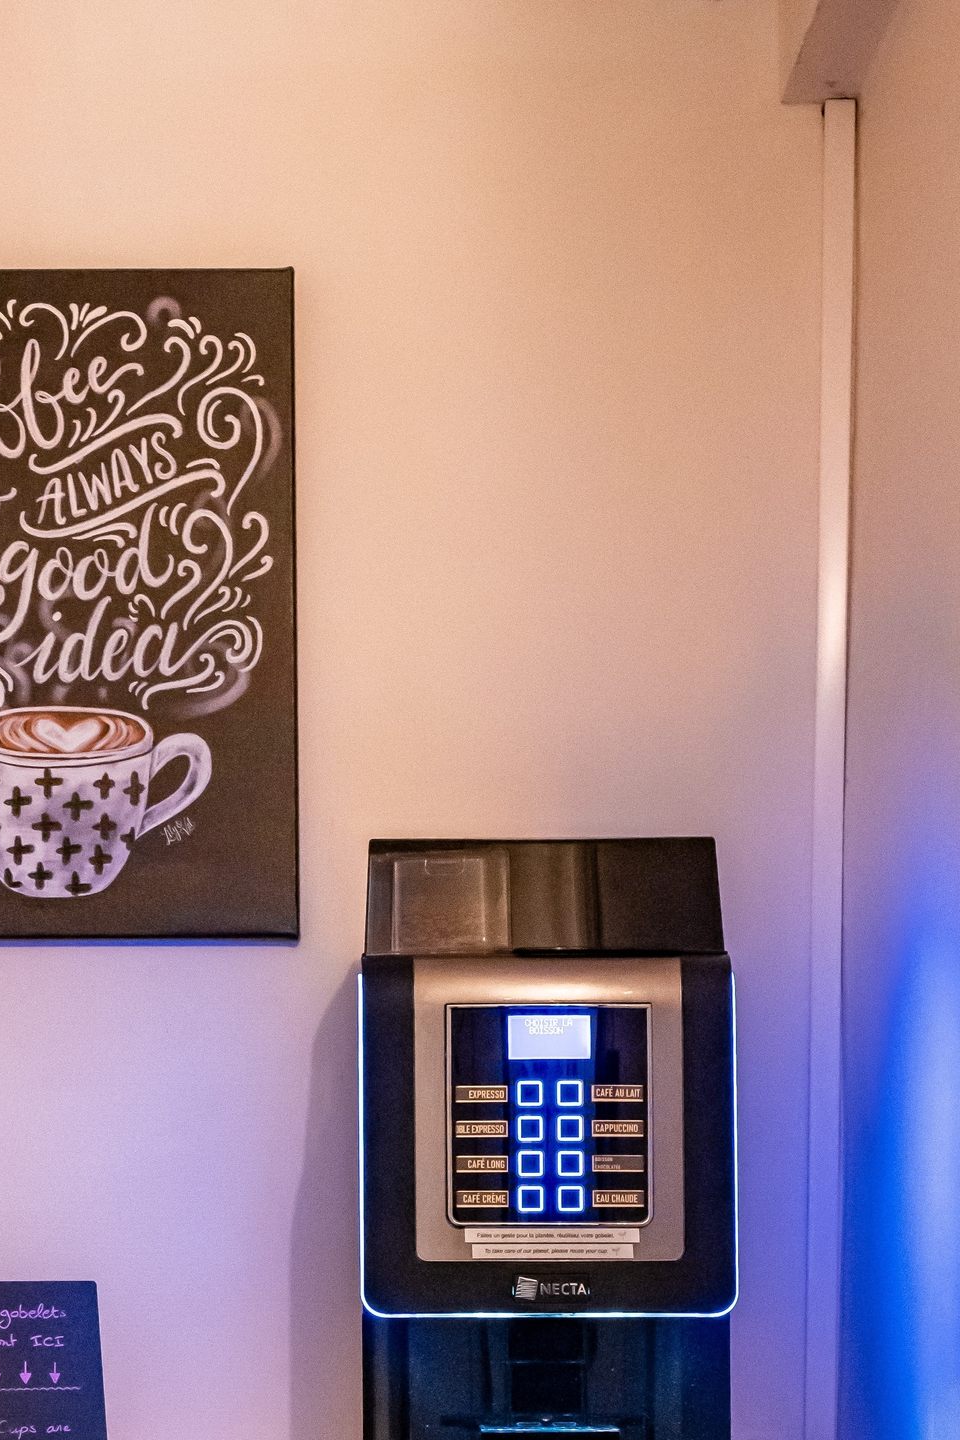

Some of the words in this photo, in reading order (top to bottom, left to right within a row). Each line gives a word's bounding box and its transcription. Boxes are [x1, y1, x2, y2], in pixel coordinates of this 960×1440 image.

[36, 432, 178, 525] ALWAYS
[11, 597, 183, 683] idea
[525, 1018, 559, 1027] CHOISIR
[562, 1018, 573, 1026] LA
[529, 1026, 564, 1035] BOISSON
[468, 1090, 505, 1099] EXPRESSO
[595, 1086, 613, 1097] CAFÉ
[615, 1088, 625, 1097] AU
[626, 1088, 641, 1097] LAIT
[471, 1124, 505, 1134] EXPRESSO
[595, 1123, 639, 1133] CAPPUCCINO
[467, 1157, 485, 1169] CAFÉ
[486, 1160, 506, 1169] LONG
[463, 1192, 480, 1203] CAFÉ
[596, 1194, 610, 1203] EAU
[611, 1194, 639, 1203] CHAUDE
[540, 1283, 587, 1295] NECTA
[30, 1335, 65, 1347] ICI
[46, 1424, 71, 1432] are
